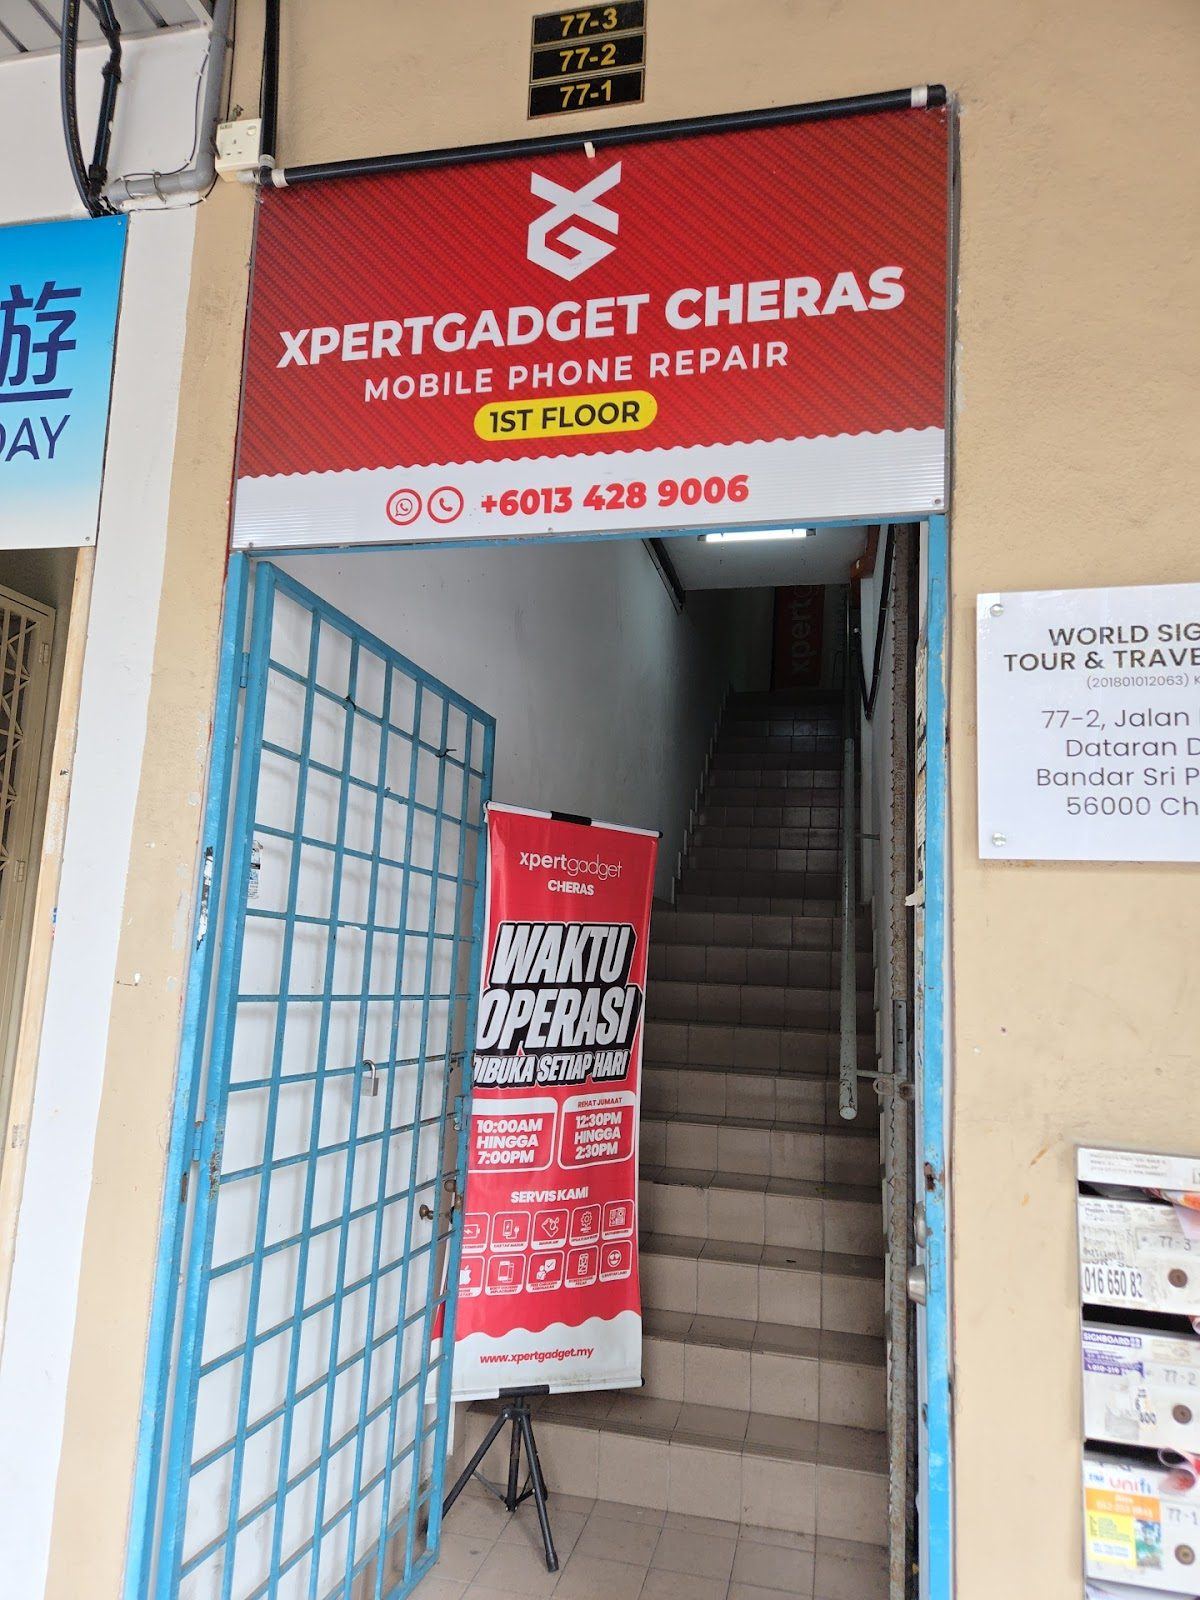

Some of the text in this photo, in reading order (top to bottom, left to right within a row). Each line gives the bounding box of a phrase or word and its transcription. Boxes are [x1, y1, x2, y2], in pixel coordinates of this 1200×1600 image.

[560, 7, 617, 37] 77-3
[560, 43, 616, 72] 77-2
[560, 80, 612, 108] 77-1
[276, 266, 905, 368] XPERTGADGET CHERAS
[364, 341, 789, 402] MOBILE PHONE REPAIR
[489, 400, 640, 433] 1ST FLOOR
[0, 414, 70, 462] AY
[481, 474, 749, 516] +6013 428 9006
[1048, 624, 1149, 646] WORLD
[1003, 652, 1076, 672] TOUR
[1084, 651, 1104, 669] &
[1087, 673, 1189, 690] (201801012063)
[1041, 707, 1190, 731] 77-2, Jalan
[1066, 738, 1177, 757] Dataran
[1036, 768, 1134, 786] Bandar
[1143, 766, 1175, 785] Sri
[1066, 796, 1199, 816] 56000 Ch
[520, 851, 622, 880] xpertgadget
[547, 879, 595, 896] CHERAS
[489, 923, 634, 985] WAKTU
[476, 985, 636, 1050] OPERASI
[537, 1052, 592, 1083] SETIAP
[592, 1049, 630, 1078] HARI
[577, 1097, 623, 1108] REHAT JUMAAT
[476, 1118, 543, 1133] 10:00AM
[575, 1111, 622, 1129] 12:30PM
[476, 1134, 539, 1149] HINGGA
[574, 1126, 621, 1145] HINGGA
[477, 1150, 534, 1165] 7:00PM
[575, 1141, 618, 1160] 2:30PM
[510, 1186, 589, 1204] SERVIS KAMI
[1084, 1267, 1104, 1294] 016
[1107, 1269, 1127, 1296] 650
[480, 1346, 593, 1364] www.xpertgadget.my
